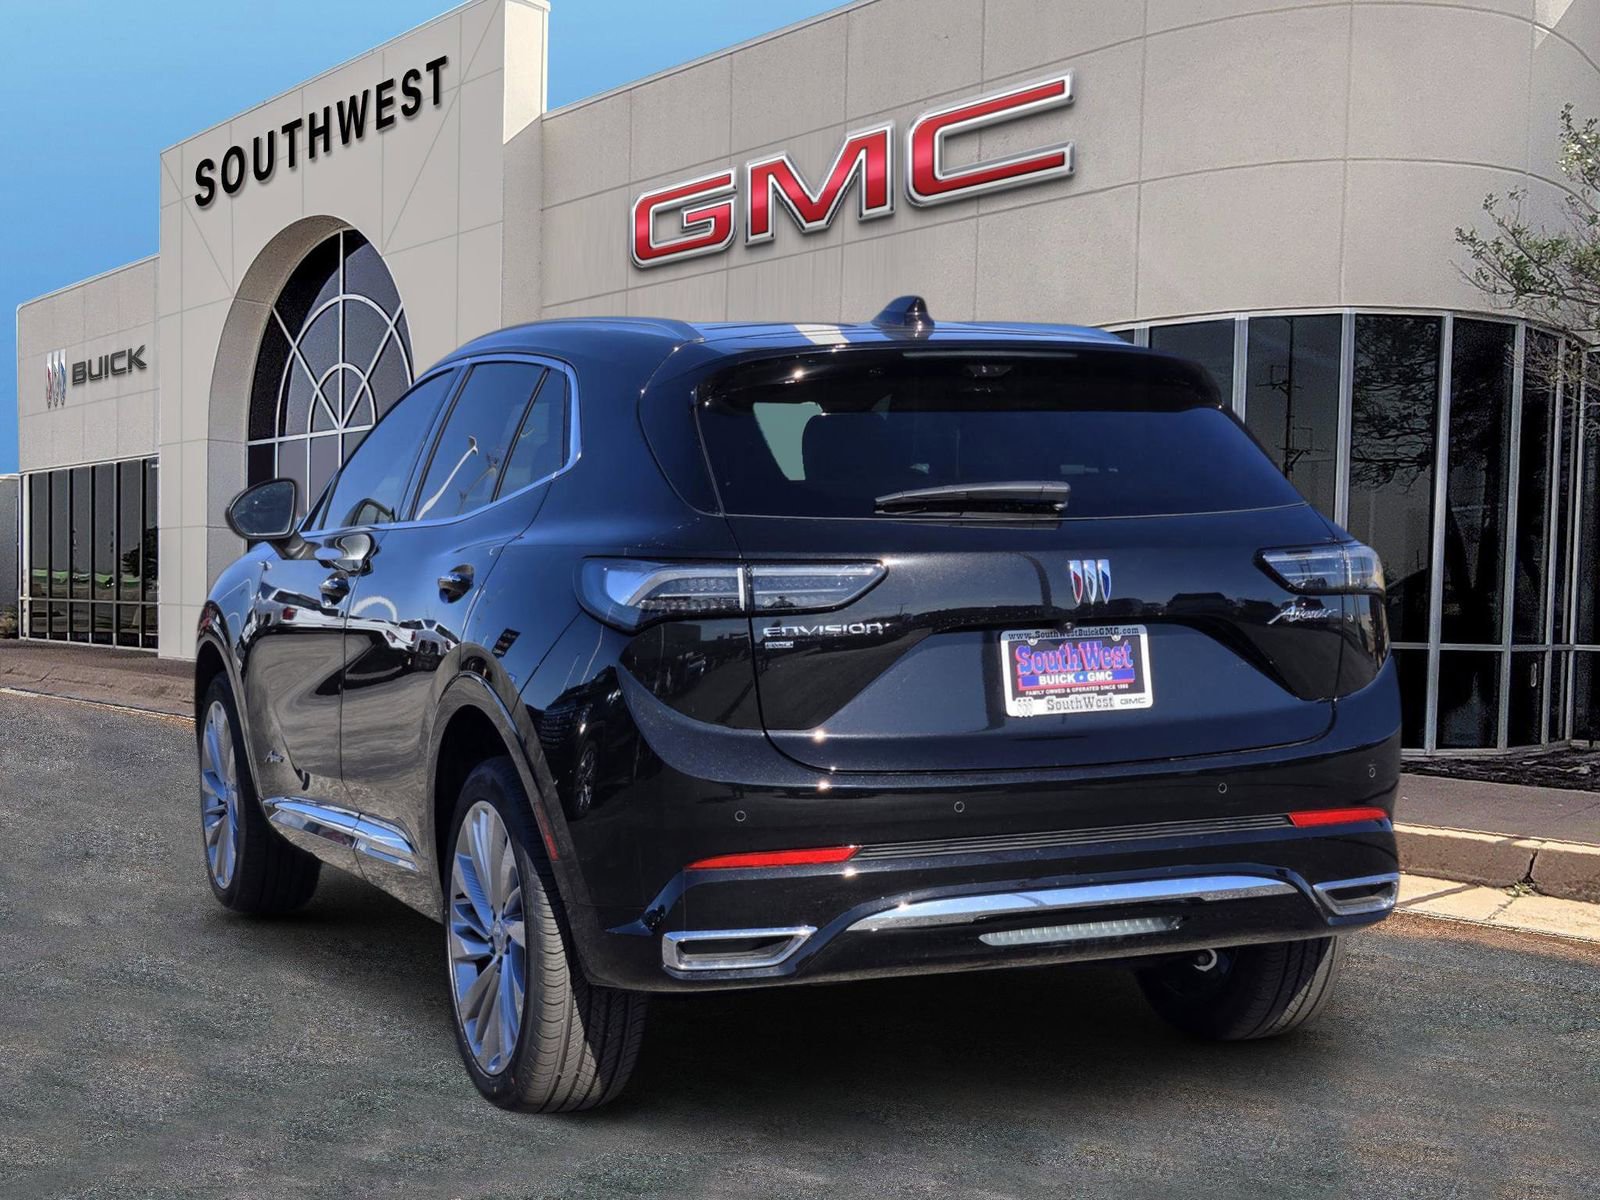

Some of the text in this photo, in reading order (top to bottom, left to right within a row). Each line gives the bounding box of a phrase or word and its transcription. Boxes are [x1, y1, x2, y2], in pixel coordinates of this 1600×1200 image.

[195, 56, 448, 207] SOUTHWEST
[630, 69, 1075, 268] GMC
[72, 344, 147, 386] BUICK
[1015, 639, 1134, 675] SouthWest
[1038, 670, 1113, 685] BUICK GMC
[1047, 696, 1147, 711] SouthWest GMC
